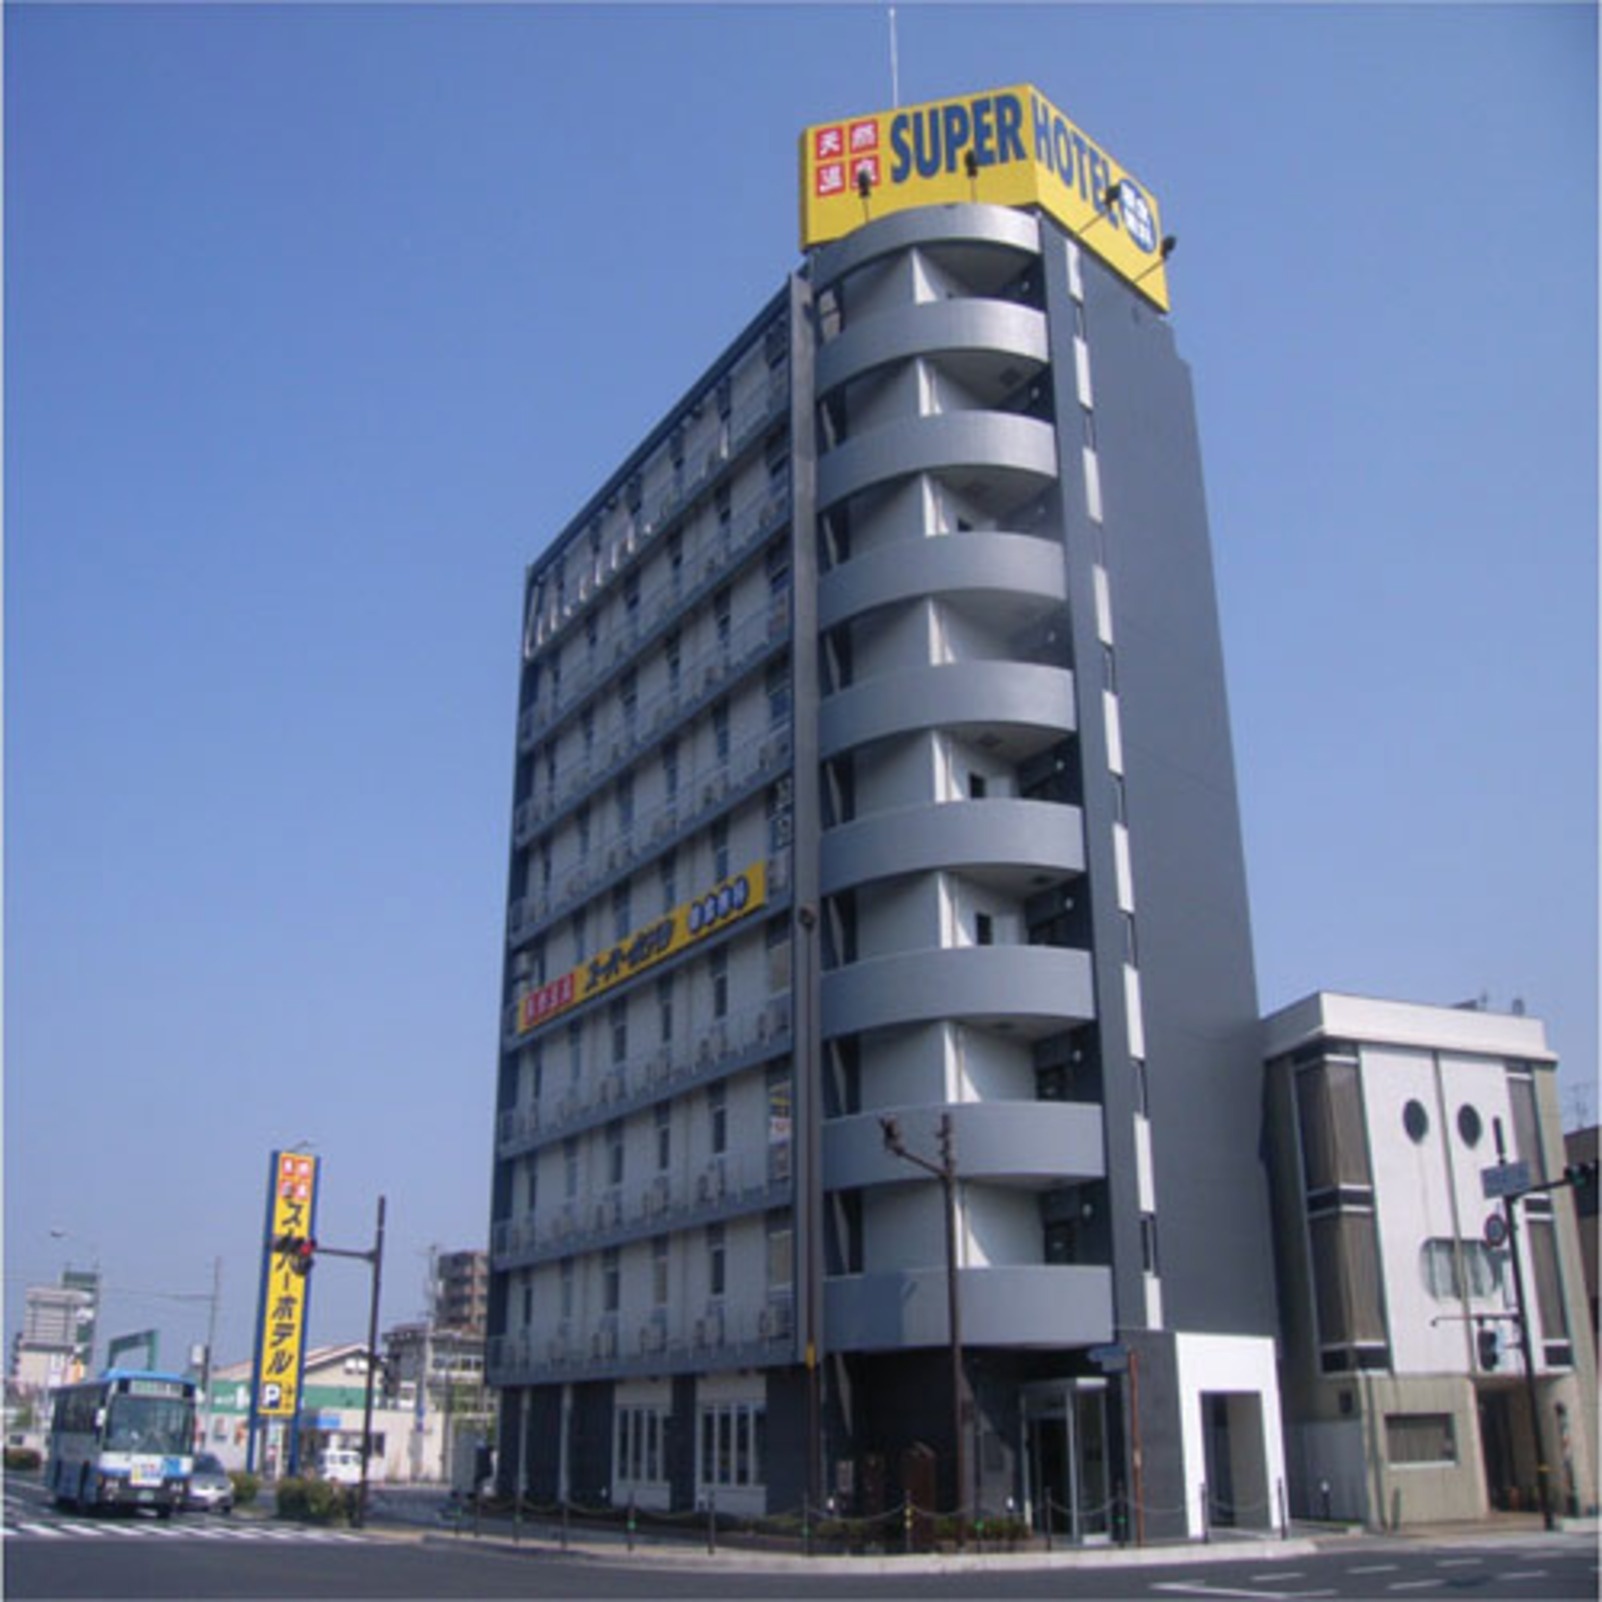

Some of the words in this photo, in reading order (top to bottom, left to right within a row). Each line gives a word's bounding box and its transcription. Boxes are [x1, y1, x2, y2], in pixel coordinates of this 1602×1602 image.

[890, 94, 1026, 183] SUPER
[1032, 92, 1119, 230] HOTEL
[265, 1202, 305, 1375] スーホテル
[261, 1383, 281, 1406] P
